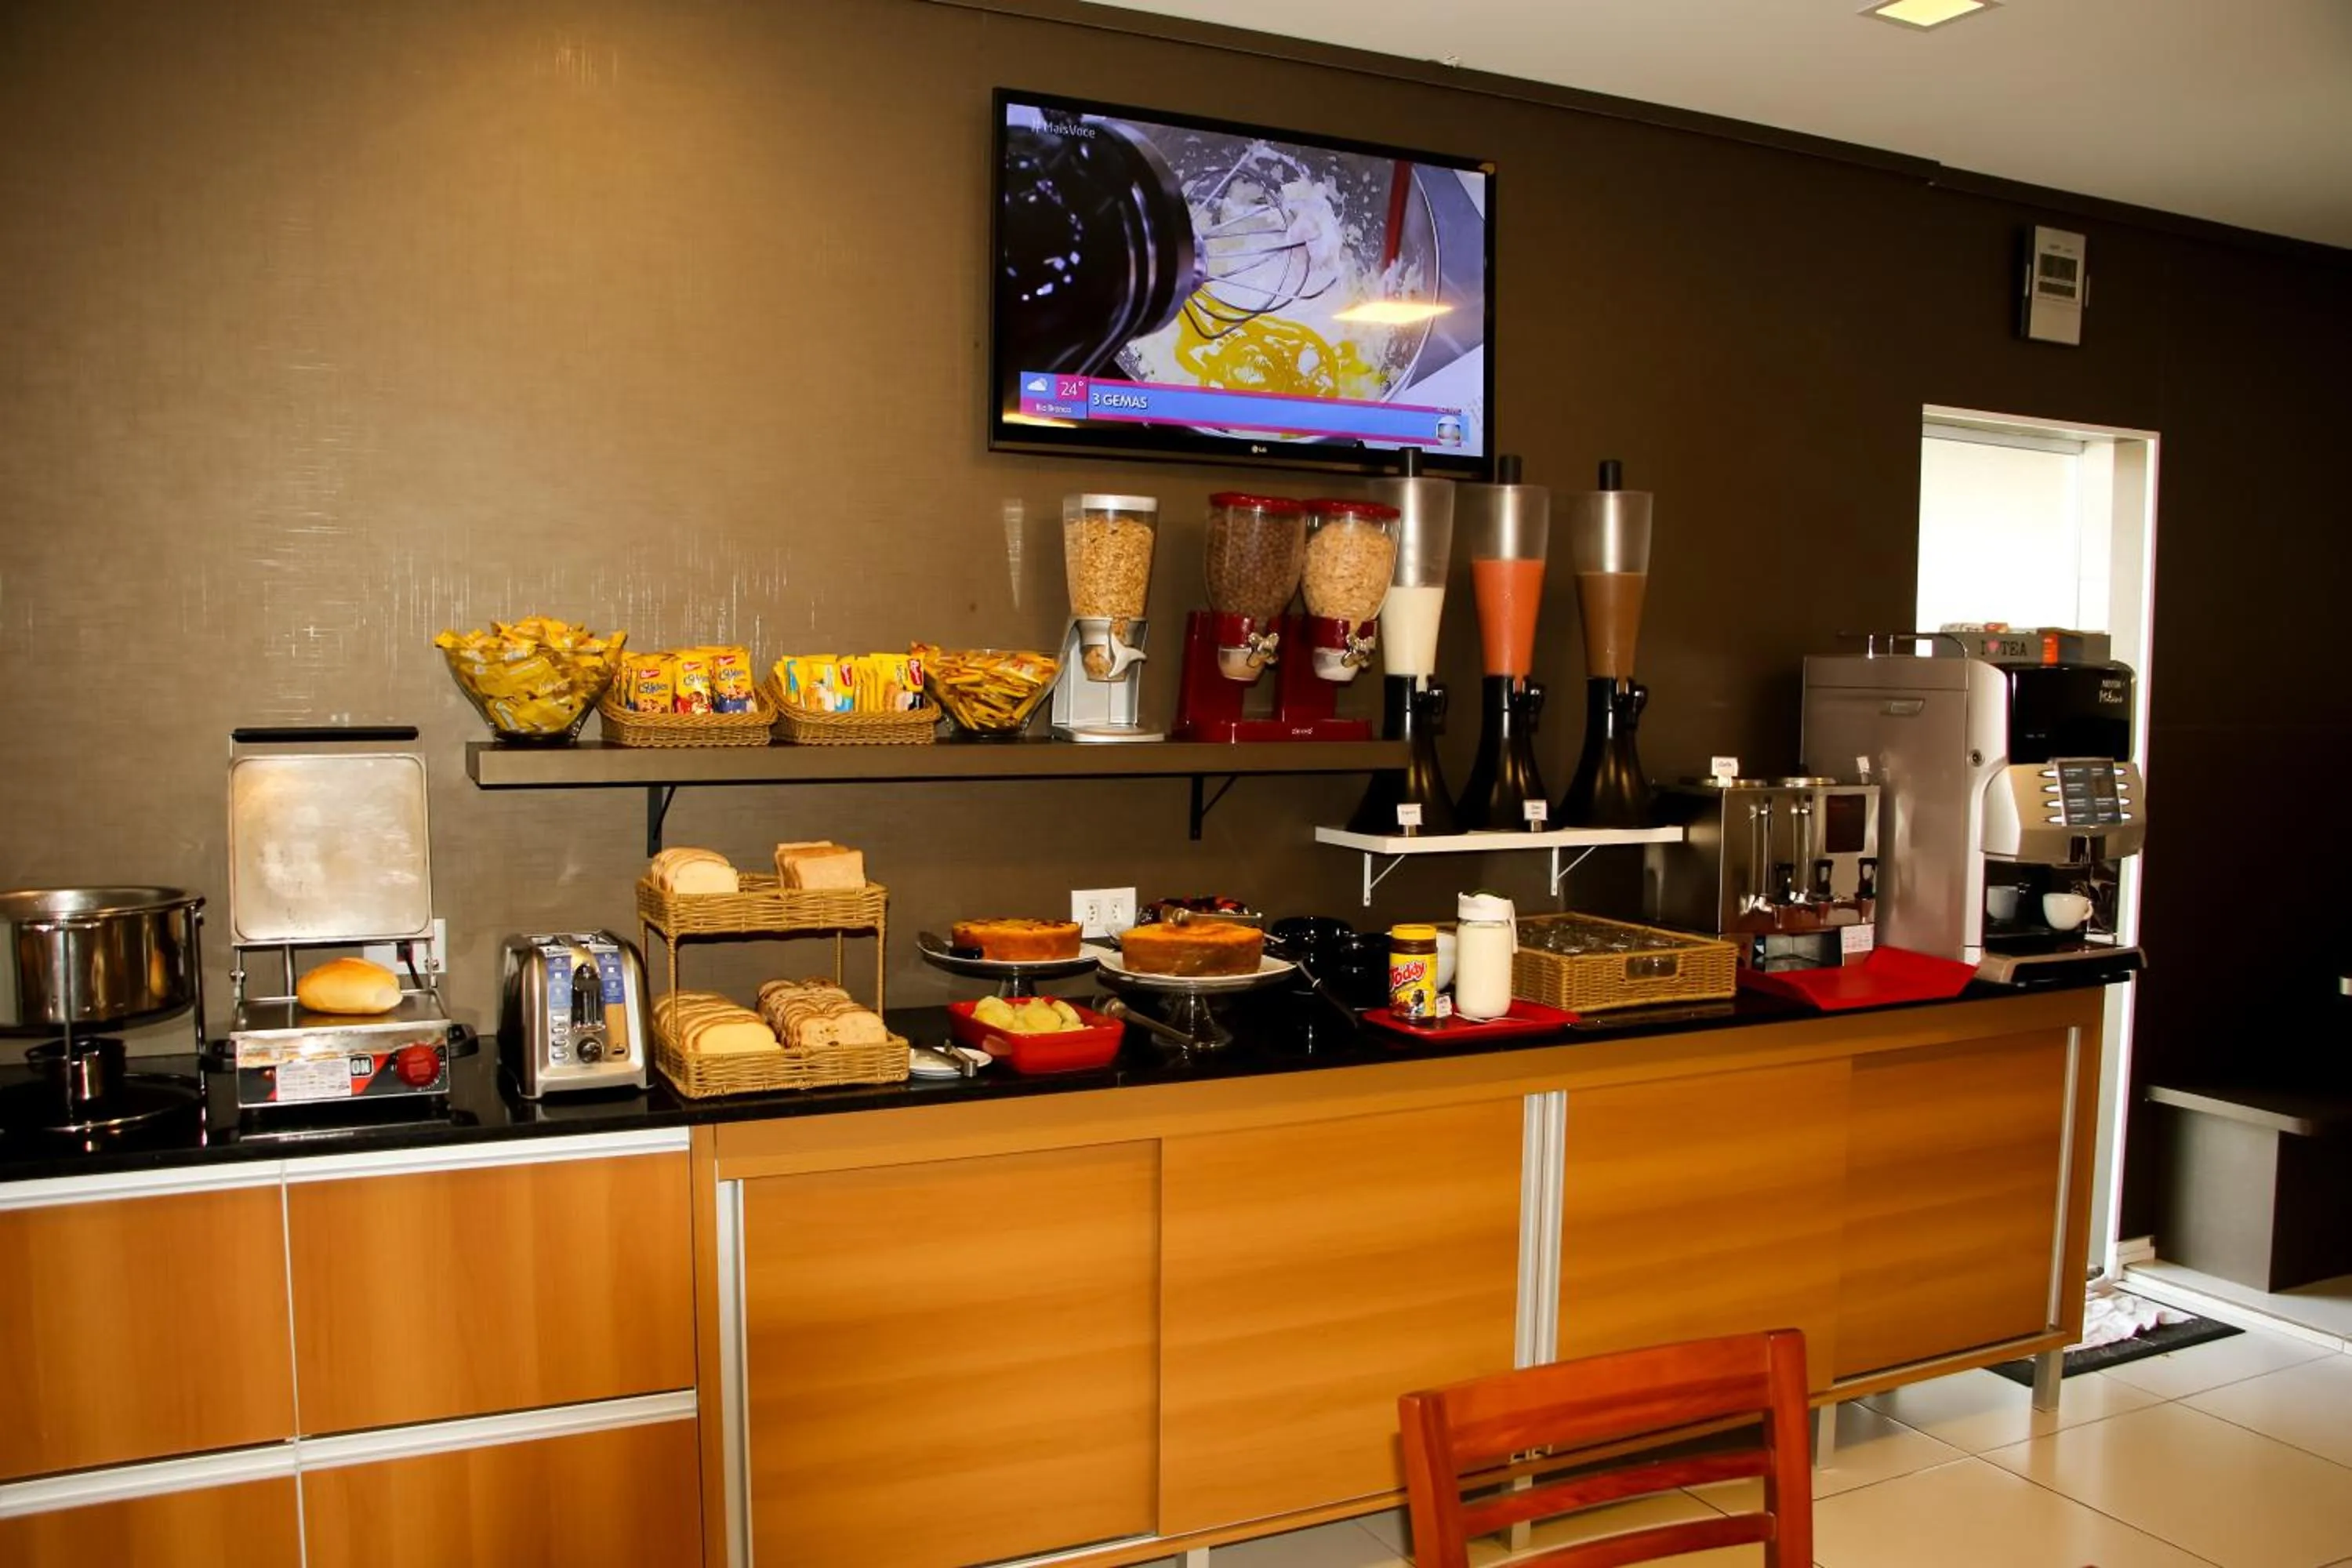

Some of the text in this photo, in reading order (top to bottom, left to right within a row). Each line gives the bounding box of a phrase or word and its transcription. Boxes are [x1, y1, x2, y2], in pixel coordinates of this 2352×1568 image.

[1092, 393, 1148, 408] 3 GEMAS
[1980, 640, 1986, 655] I
[2002, 640, 2027, 656] TEA
[1390, 961, 1426, 988] Toddy
